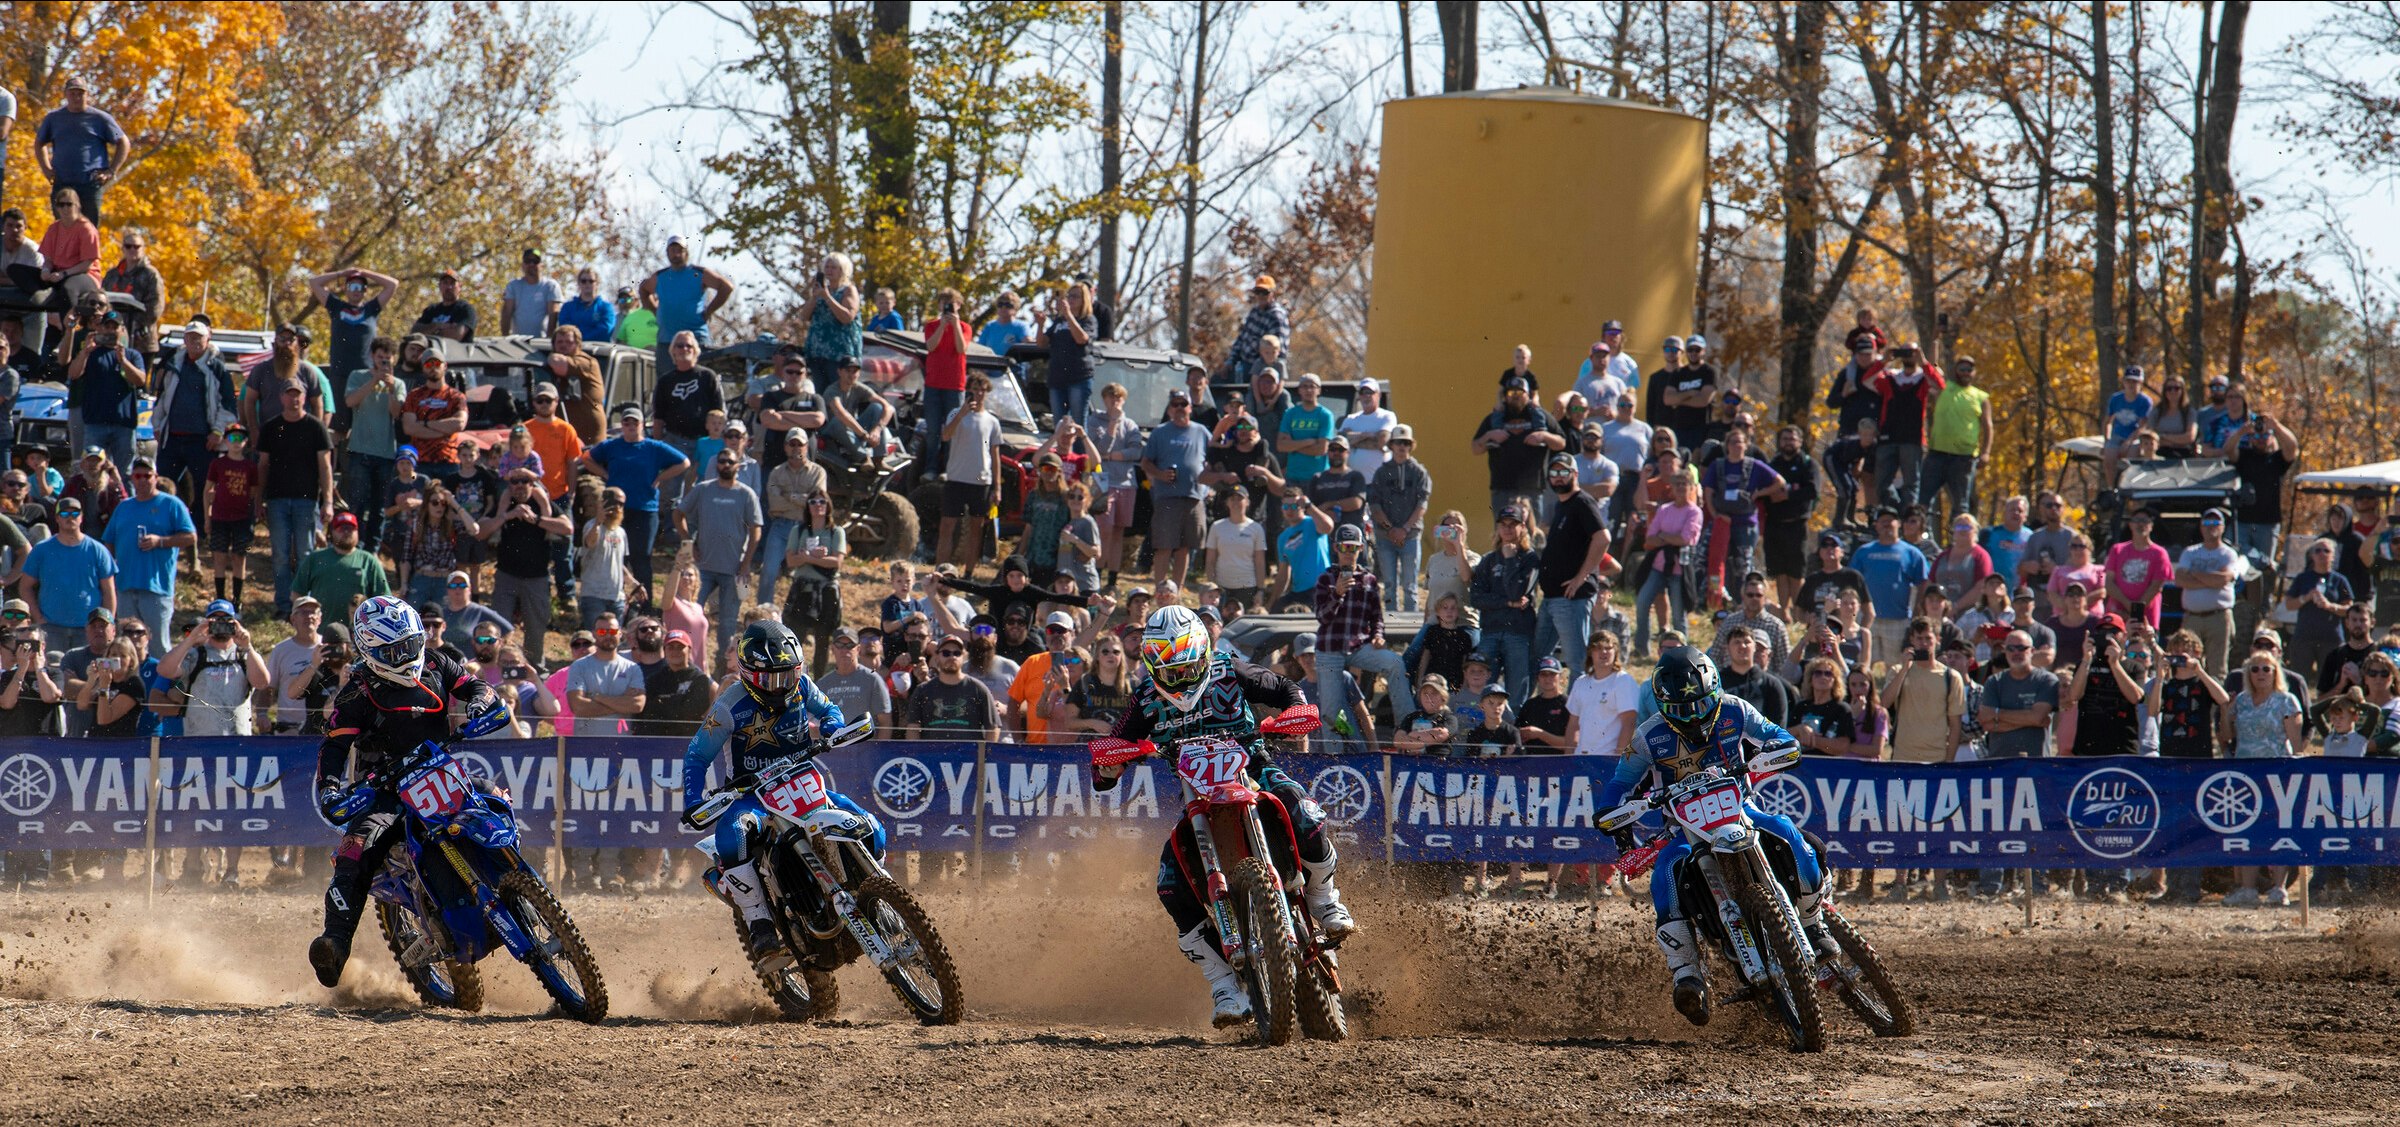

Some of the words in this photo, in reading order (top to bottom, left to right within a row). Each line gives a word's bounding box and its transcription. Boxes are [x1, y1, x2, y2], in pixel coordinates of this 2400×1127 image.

[1154, 707, 1213, 731] GASGAS
[1275, 717, 1307, 728] ACERBIS
[1105, 747, 1140, 755] ACERBIS
[1190, 751, 1243, 785] 212
[61, 756, 286, 811] YAMAHA
[407, 761, 469, 818] 514
[771, 773, 825, 816] 342
[939, 762, 1160, 818] YAMAHA
[1376, 771, 1595, 828] YAMAHA
[1684, 788, 1740, 829] 989
[1815, 777, 2043, 832] YAMAHA
[18, 818, 269, 834] RACING
[896, 823, 1143, 838] RACING
[2103, 835, 2133, 844] YAMAHA
[1826, 840, 2028, 854] ACING
[2223, 837, 2384, 851] RACI
[847, 911, 881, 955] DUNLOP
[1218, 900, 1231, 934] DUNLOP
[1731, 921, 1753, 967] DUNLOP
